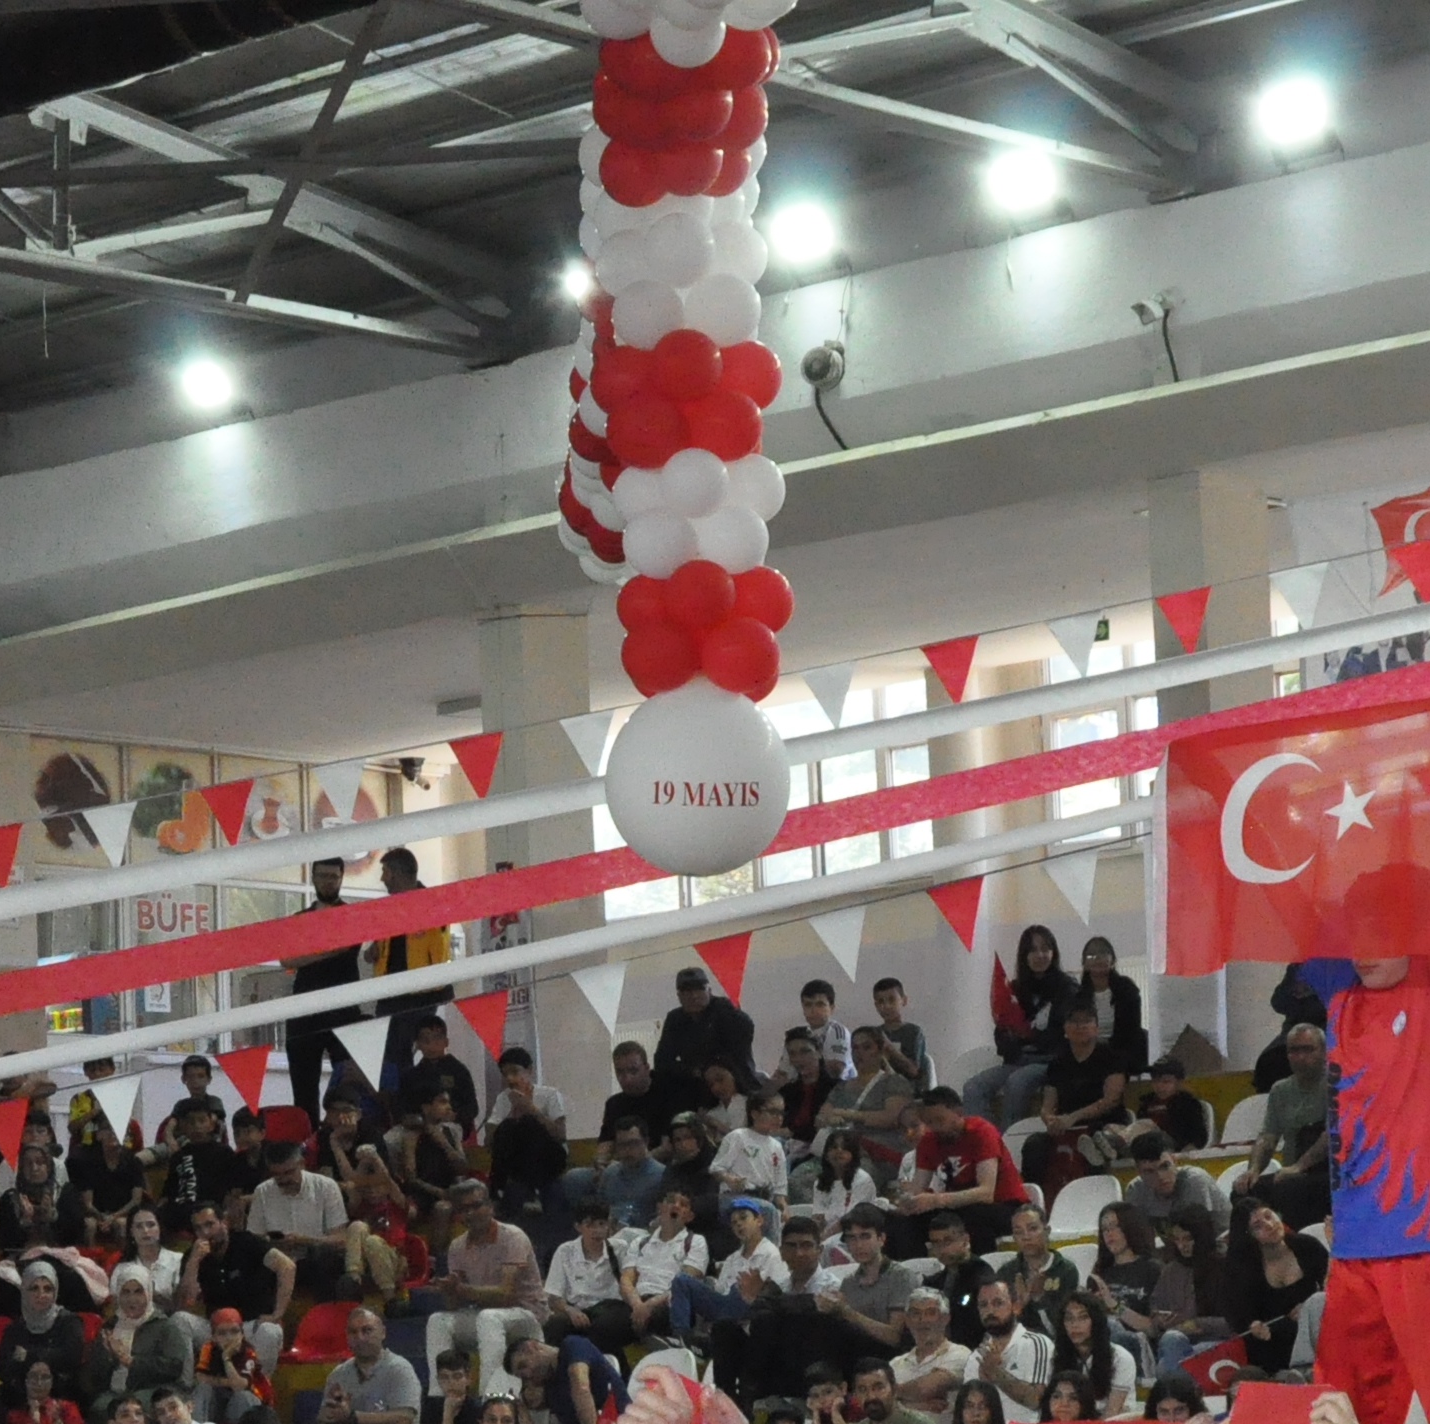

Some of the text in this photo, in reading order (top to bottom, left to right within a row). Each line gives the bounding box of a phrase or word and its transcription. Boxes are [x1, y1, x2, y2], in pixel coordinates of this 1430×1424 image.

[653, 780, 759, 807] 19 MAYIS
[137, 892, 210, 933] BÜFE
